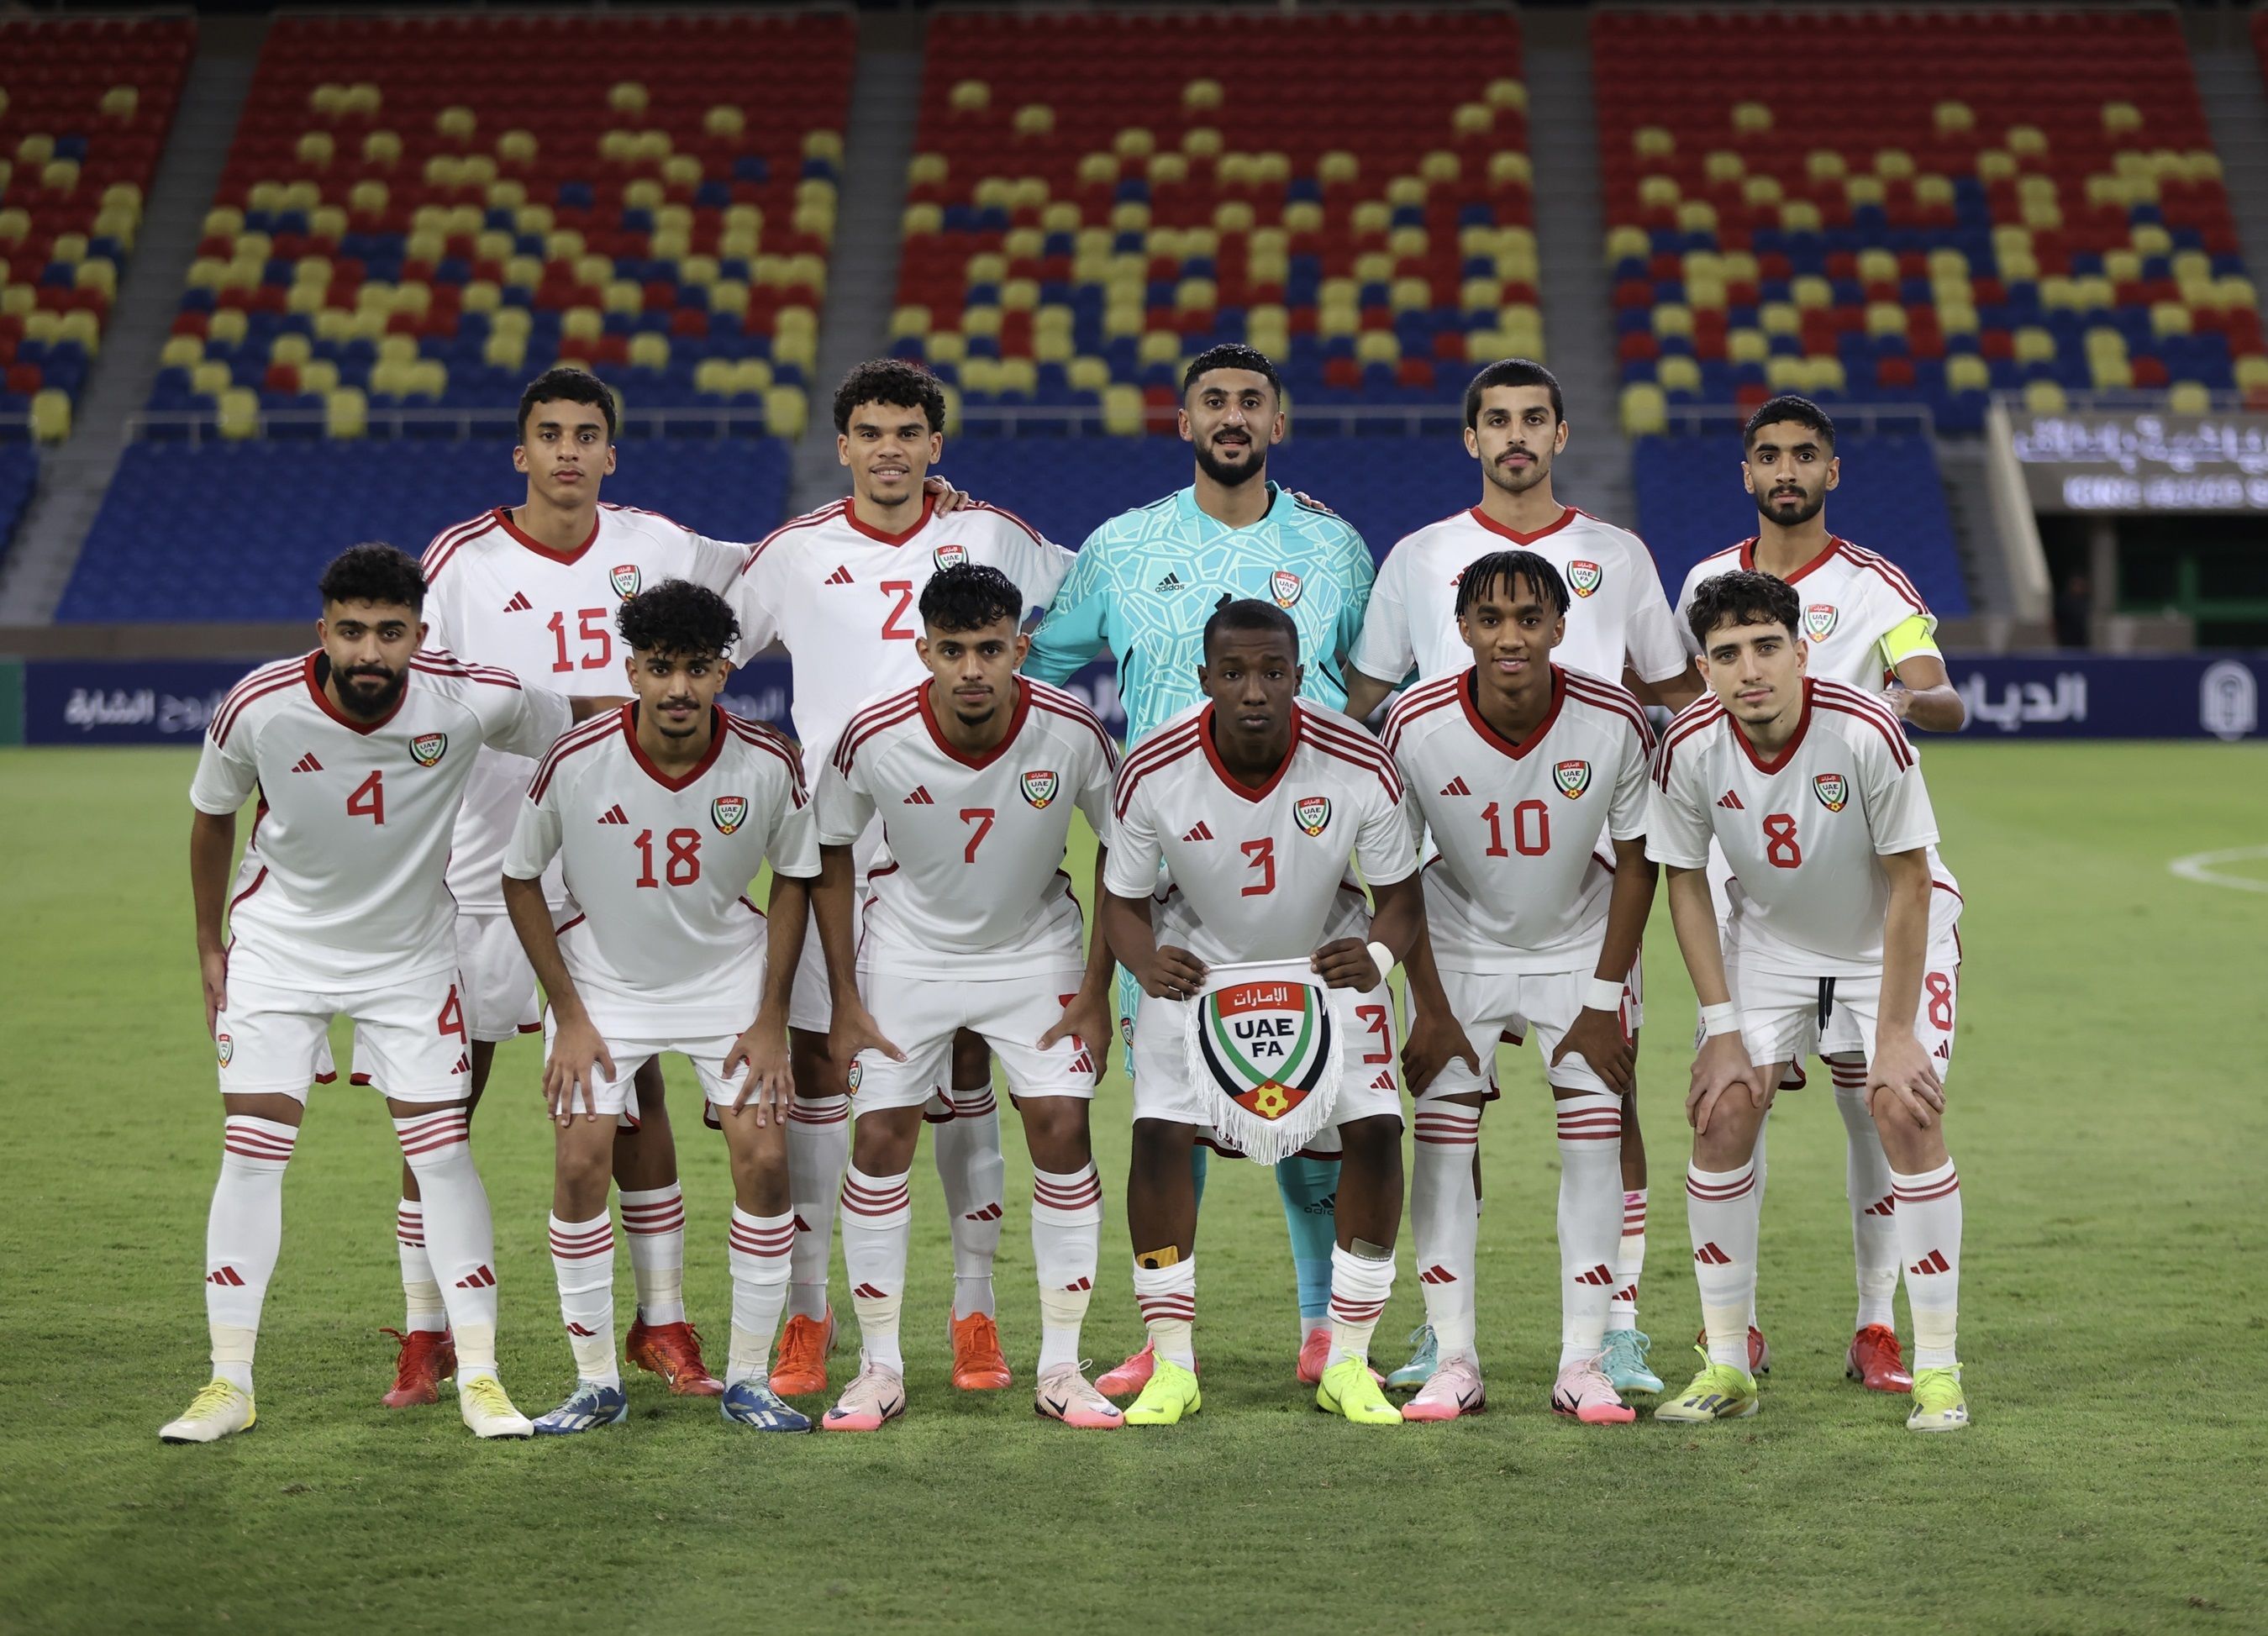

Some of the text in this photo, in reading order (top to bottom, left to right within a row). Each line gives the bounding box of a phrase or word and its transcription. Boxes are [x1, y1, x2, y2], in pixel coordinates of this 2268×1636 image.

[881, 581, 914, 639] 2
[1155, 584, 1185, 592] adidas
[547, 608, 612, 672] 15
[346, 770, 385, 825] 4
[960, 808, 995, 864] 7
[1481, 800, 1550, 857] 10
[1762, 813, 1802, 869] 8
[634, 829, 703, 888] 18
[1240, 837, 1276, 897] 3
[438, 984, 467, 1044] 4
[1234, 986, 1288, 1007] الإمارات
[1925, 971, 1953, 1032] 8
[1234, 1018, 1295, 1039] UAE
[1251, 1040, 1285, 1058] FA
[1355, 1005, 1393, 1064] 3
[1304, 1207, 1334, 1216] adi
